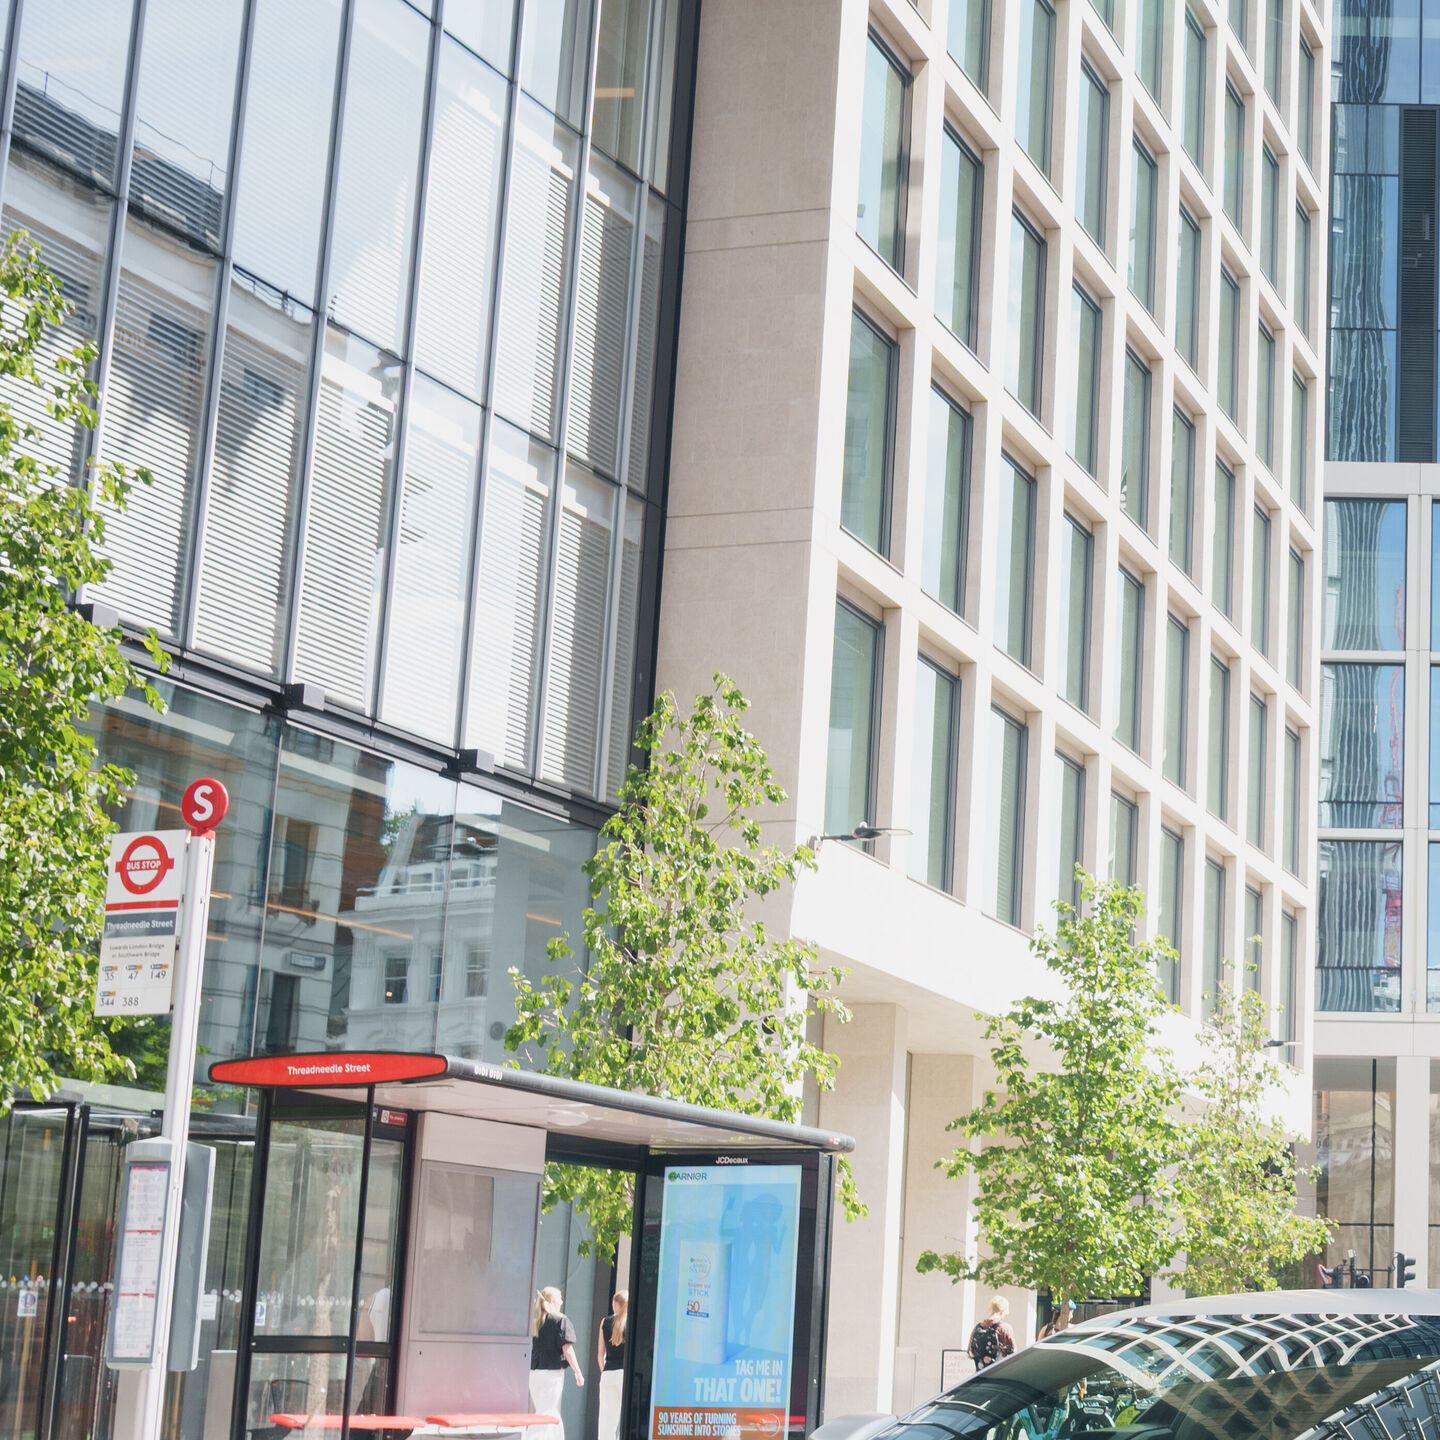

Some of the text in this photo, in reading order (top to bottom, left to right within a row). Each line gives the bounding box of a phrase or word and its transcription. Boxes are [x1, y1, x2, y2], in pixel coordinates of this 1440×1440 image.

[191, 785, 213, 822] S
[126, 858, 161, 871] BUS STOP
[106, 919, 174, 931] Threadneedle Street
[104, 970, 167, 981] 35 47 149
[99, 996, 139, 1007] 344 388
[287, 1063, 371, 1075] Threadneedle Street
[715, 1156, 749, 1165] JCDecaux
[735, 1360, 783, 1375] TAG ME IN
[694, 1377, 782, 1403] THAT ONE!
[658, 1412, 737, 1425] 90 YEARS OF TURNING
[657, 1424, 742, 1437] SUNSHINE INTO STORIES
